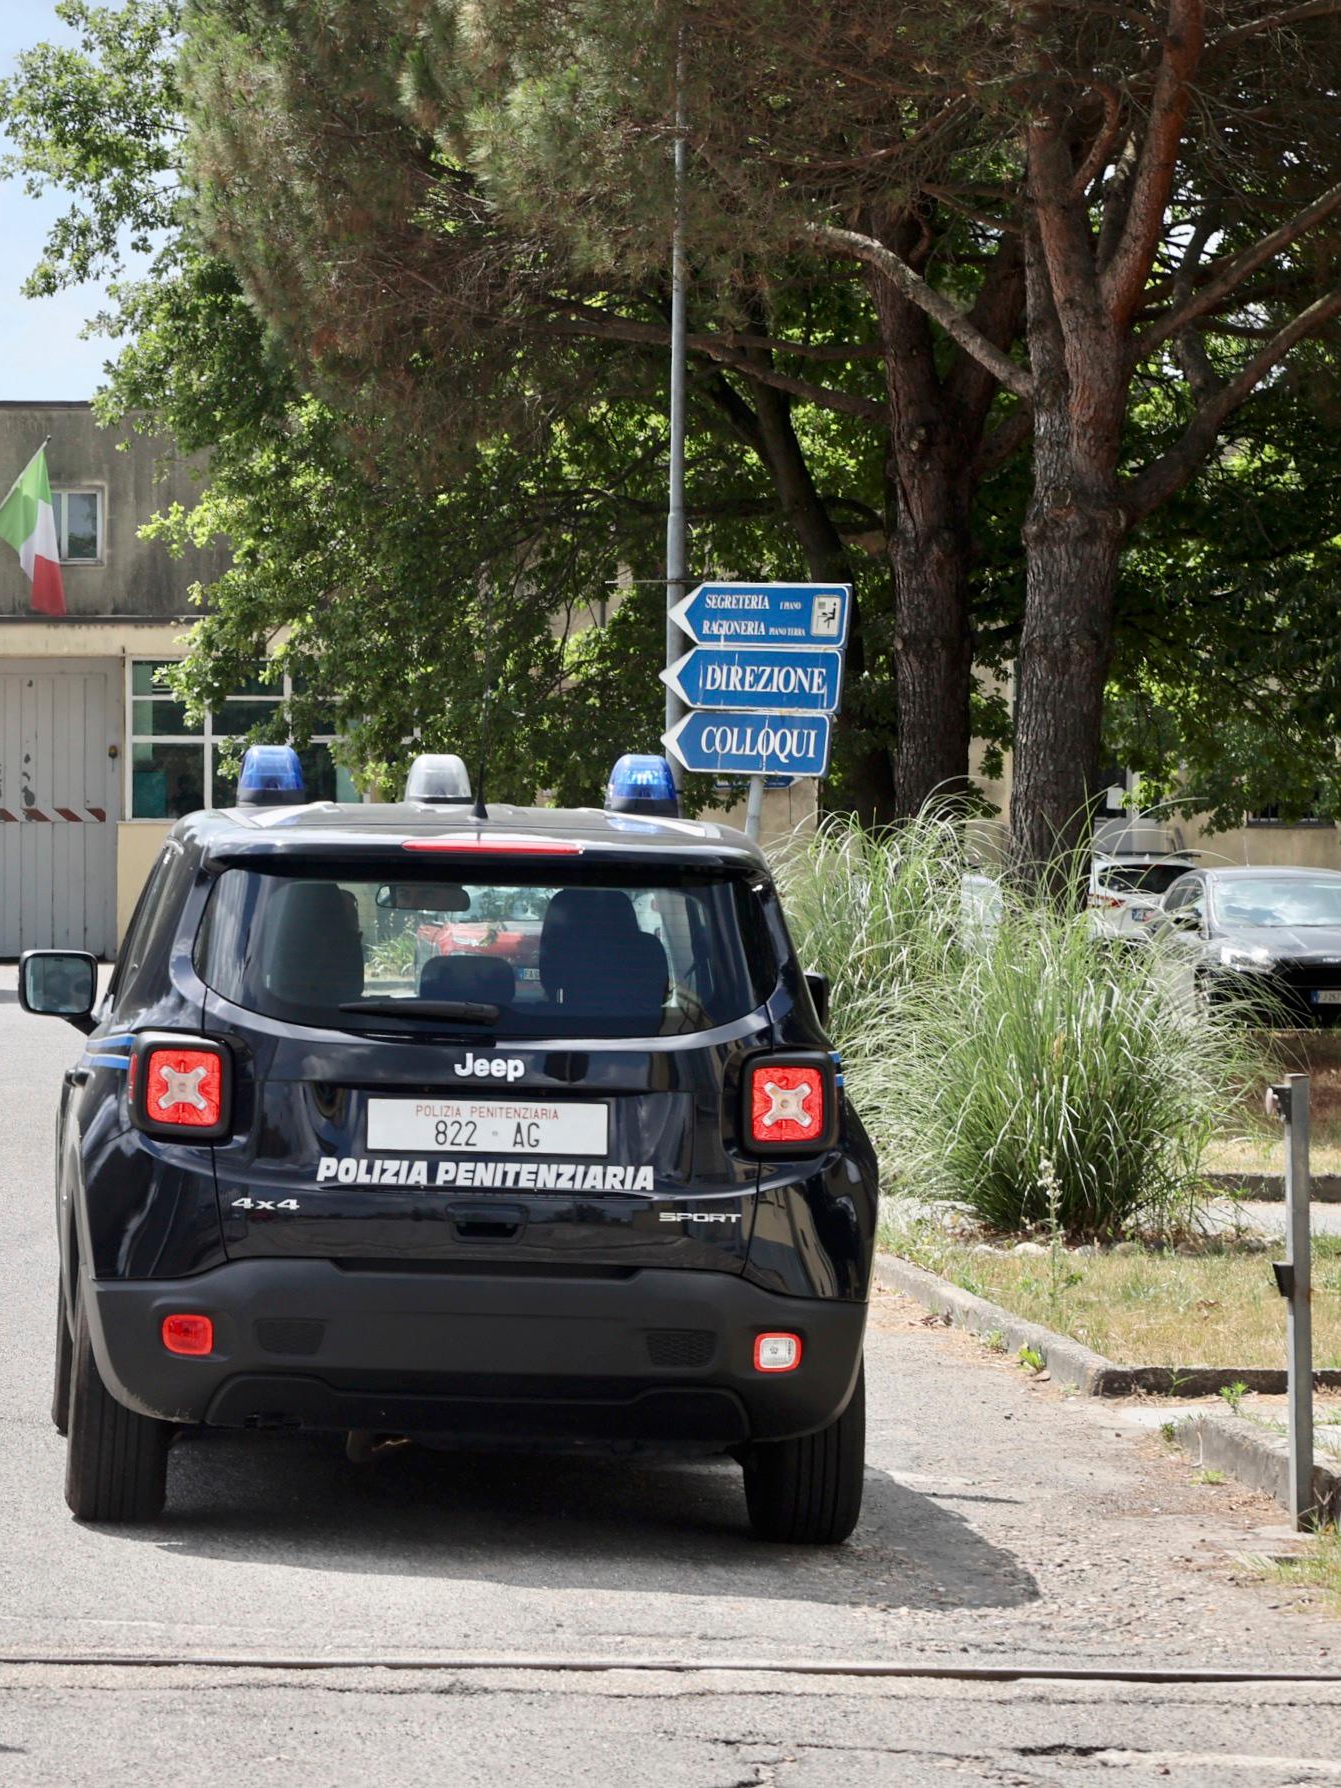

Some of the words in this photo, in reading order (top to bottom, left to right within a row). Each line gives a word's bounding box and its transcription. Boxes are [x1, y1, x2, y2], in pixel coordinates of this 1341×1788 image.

[705, 594, 770, 609] SEGRETERIA
[702, 620, 766, 635] RAGIONERIA
[705, 665, 826, 694] DIREZIONE
[701, 726, 818, 763] COLLOQUI
[454, 1053, 525, 1082] Jeep
[416, 1105, 462, 1117] POLIZIA
[470, 1106, 559, 1120] PENITENZIARIA
[435, 1120, 477, 1147] 822
[513, 1122, 540, 1148] AG
[316, 1157, 428, 1185] POLIZIA
[435, 1161, 655, 1191] PENITENZIARIA
[231, 1197, 301, 1210] 4x4
[659, 1212, 742, 1223] SPORT
